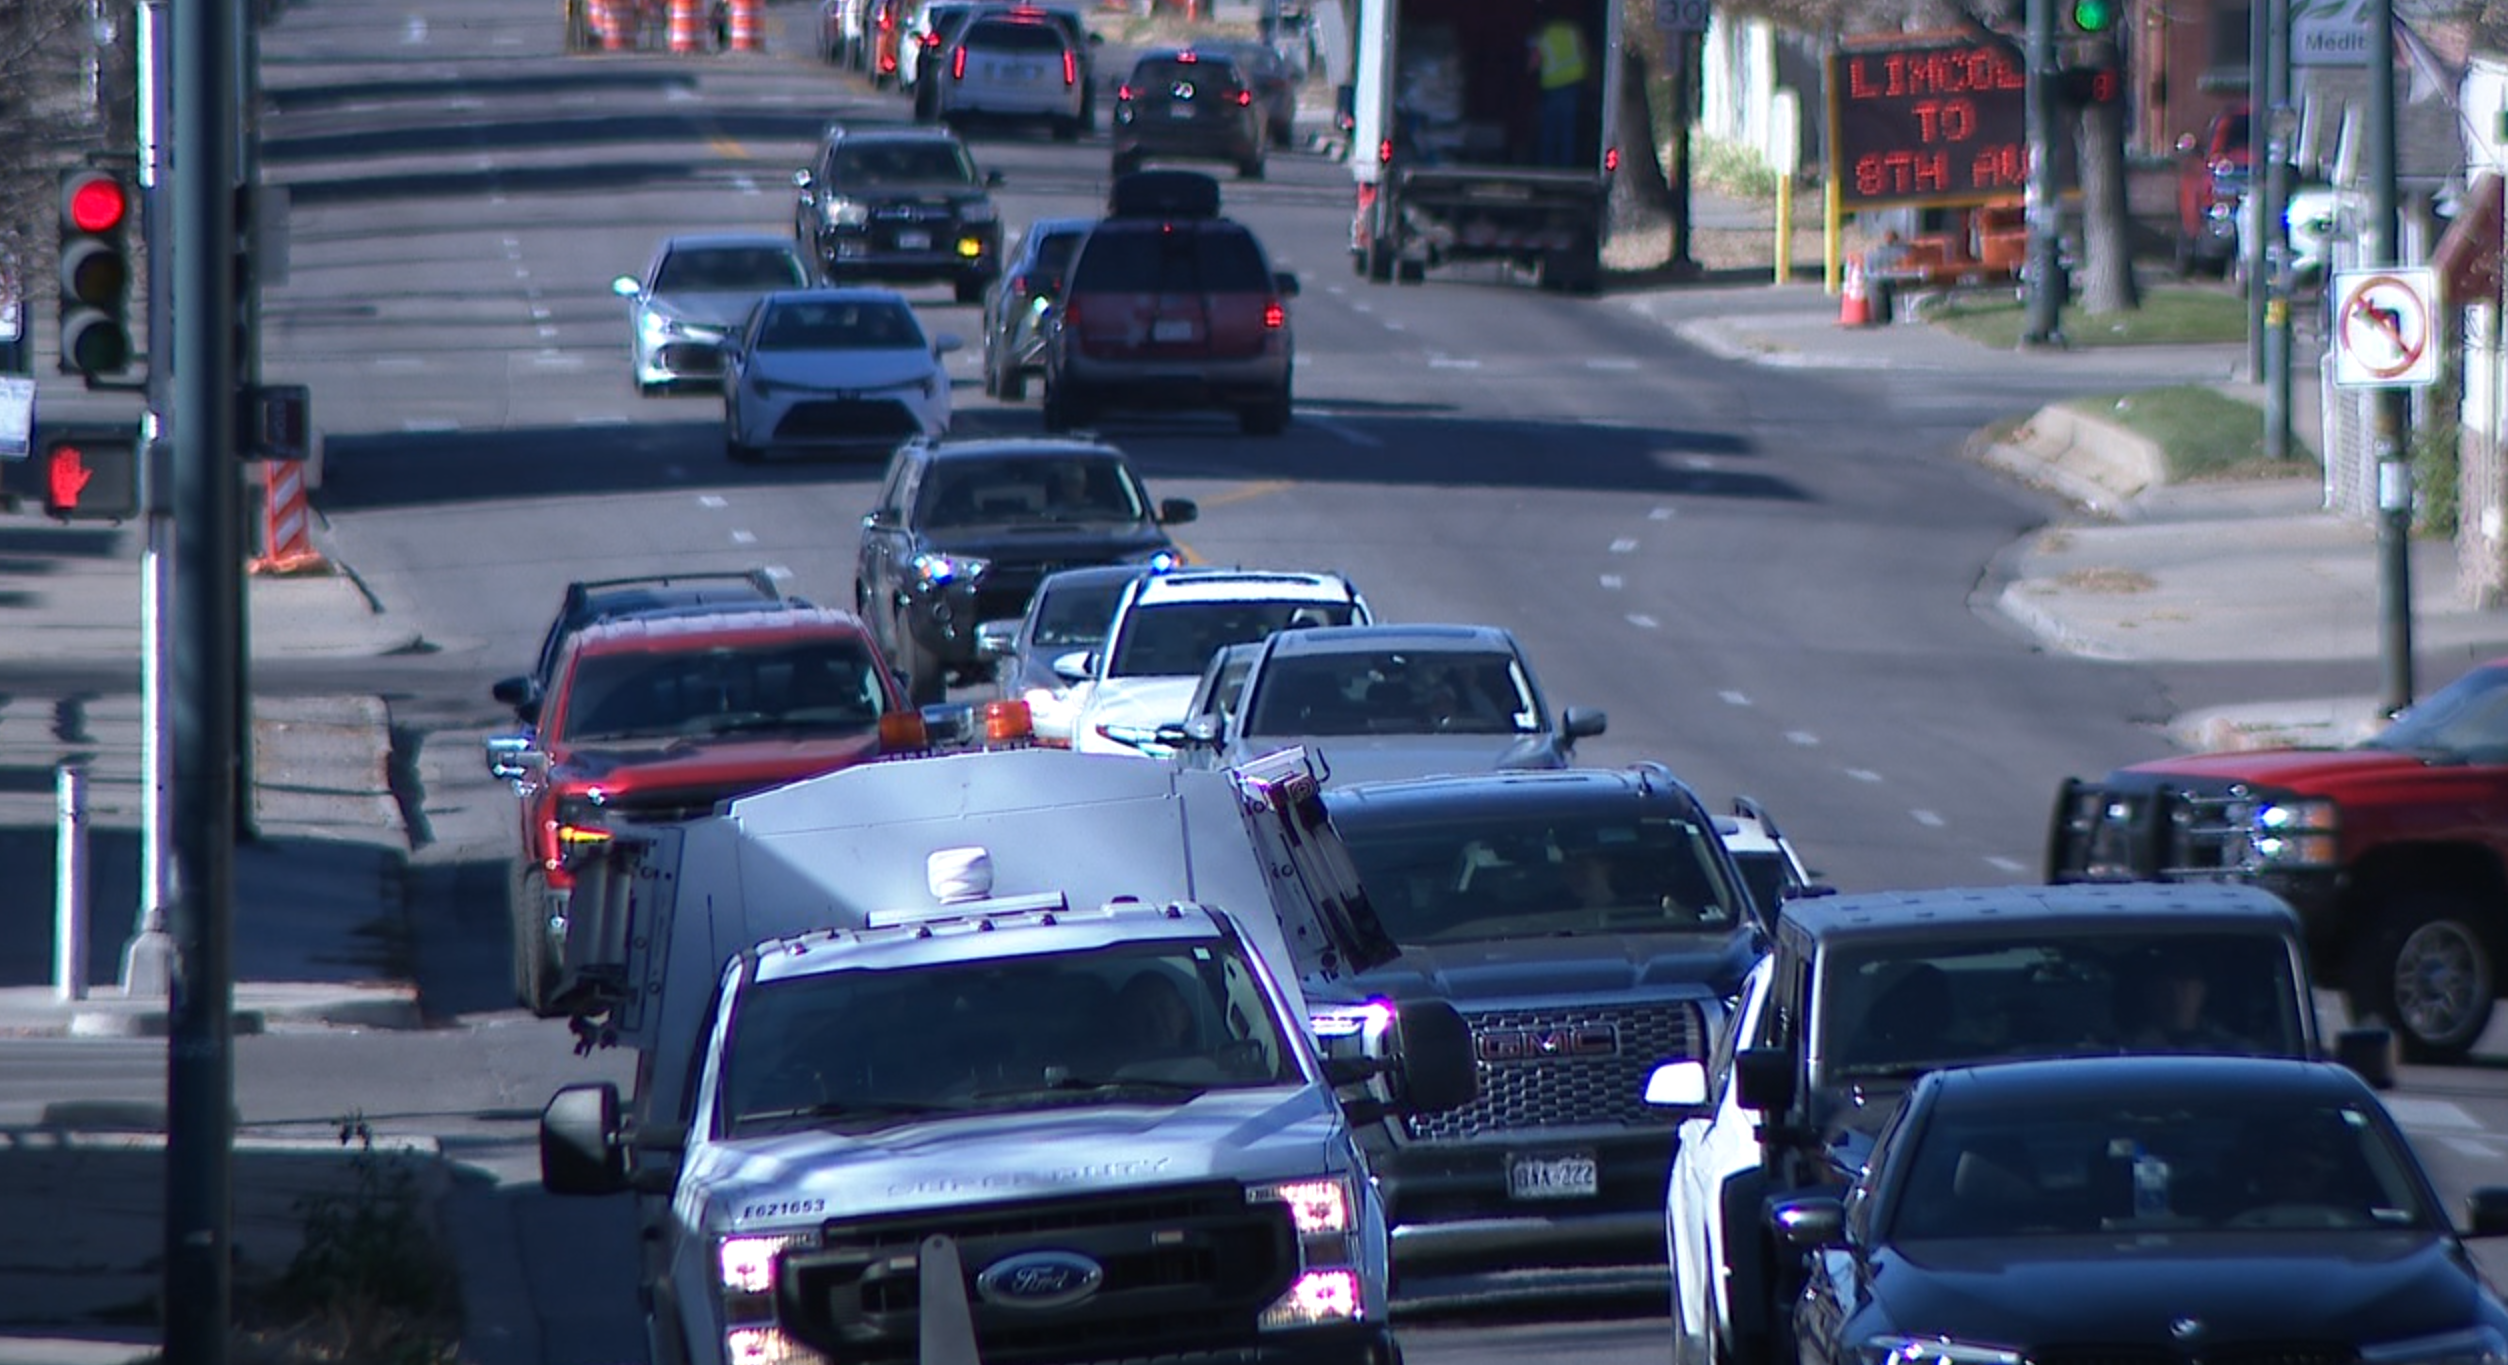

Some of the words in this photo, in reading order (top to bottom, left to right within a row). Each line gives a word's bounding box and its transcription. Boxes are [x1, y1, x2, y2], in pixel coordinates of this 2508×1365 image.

[1659, 0, 1702, 24] 30
[2305, 31, 2368, 51] Medit
[1849, 47, 2025, 98] LINCOL
[1912, 99, 1976, 143] TO
[1856, 150, 1949, 196] 8TH
[1972, 143, 2029, 188] AV
[1478, 1022, 1618, 1061] GMC
[1011, 1264, 1069, 1293] Ford
